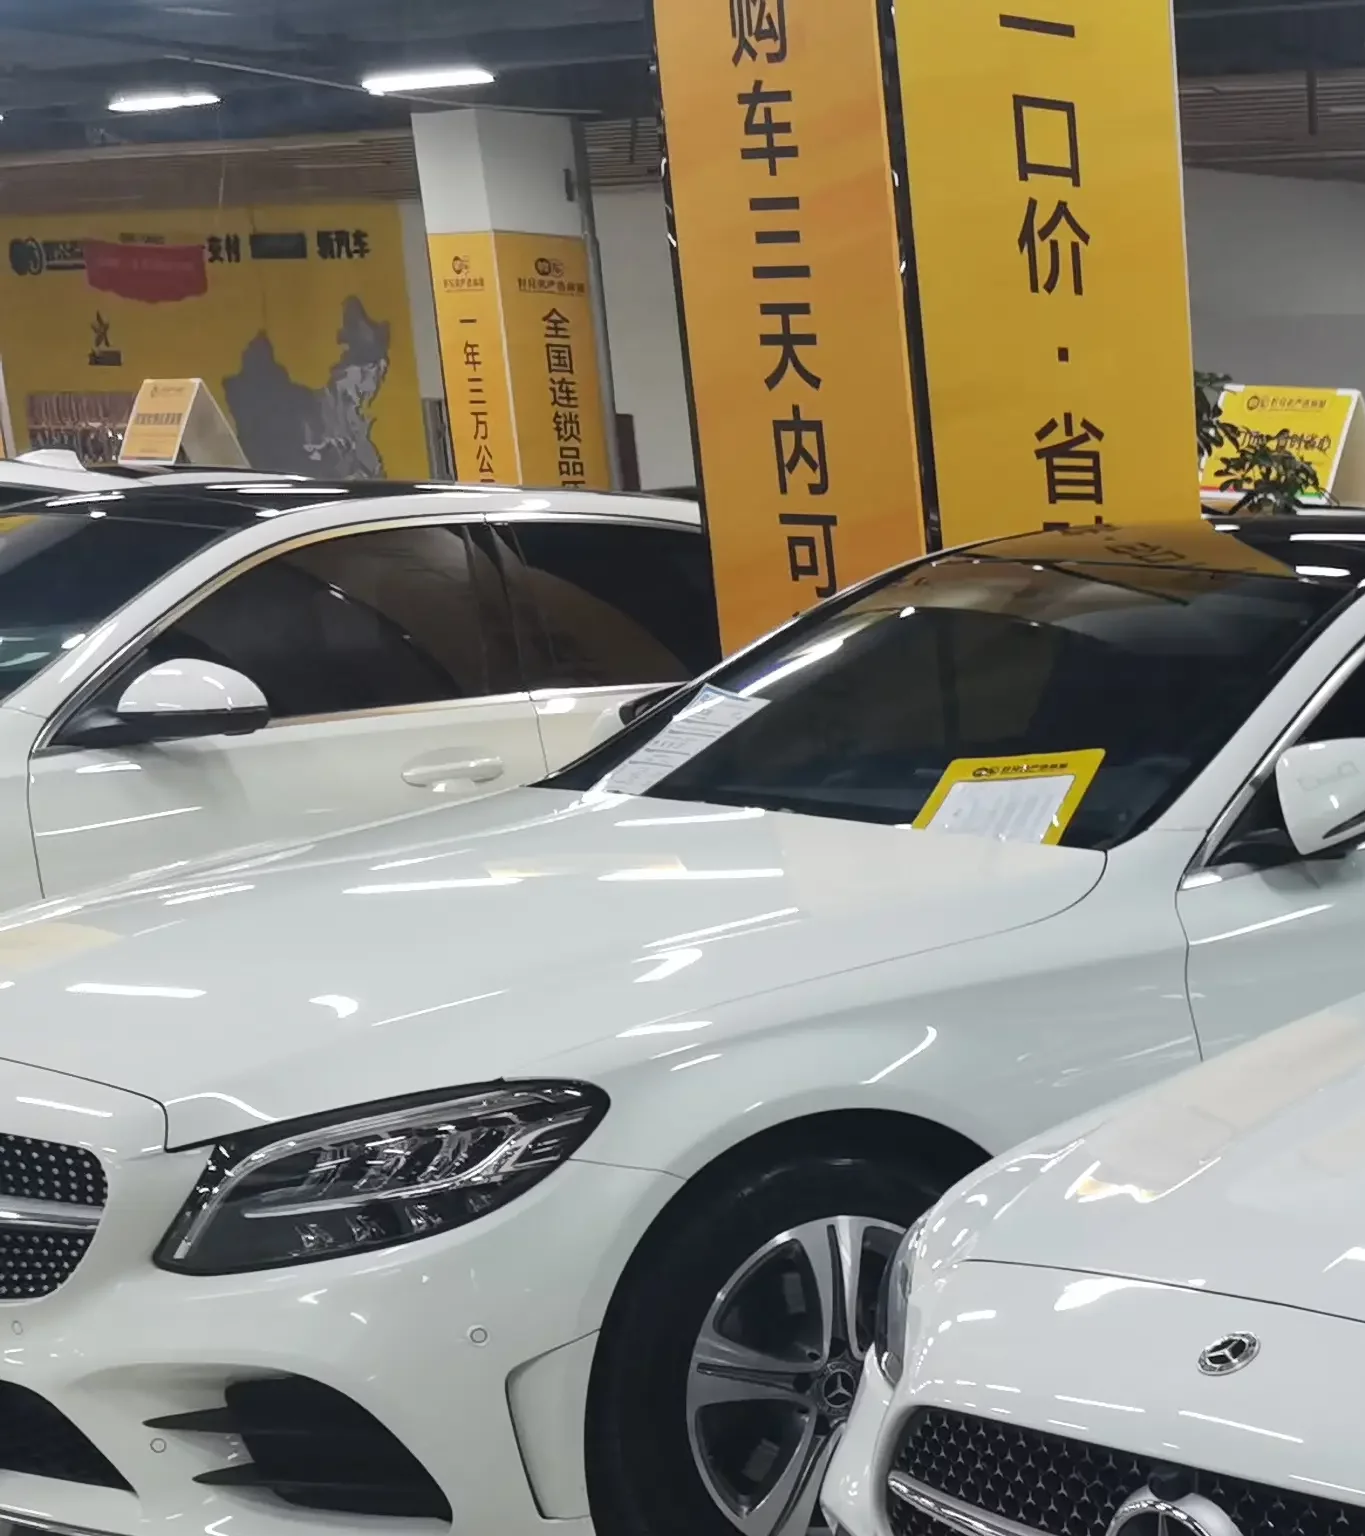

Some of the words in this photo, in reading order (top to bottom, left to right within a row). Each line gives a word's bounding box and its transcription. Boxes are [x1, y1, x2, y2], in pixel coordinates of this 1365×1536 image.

[459, 318, 496, 483] 一年三万公
[541, 307, 586, 488] 全国连锁品
[728, 0, 838, 616] 购车三天内可
[998, 13, 1105, 530] 一口价·省
